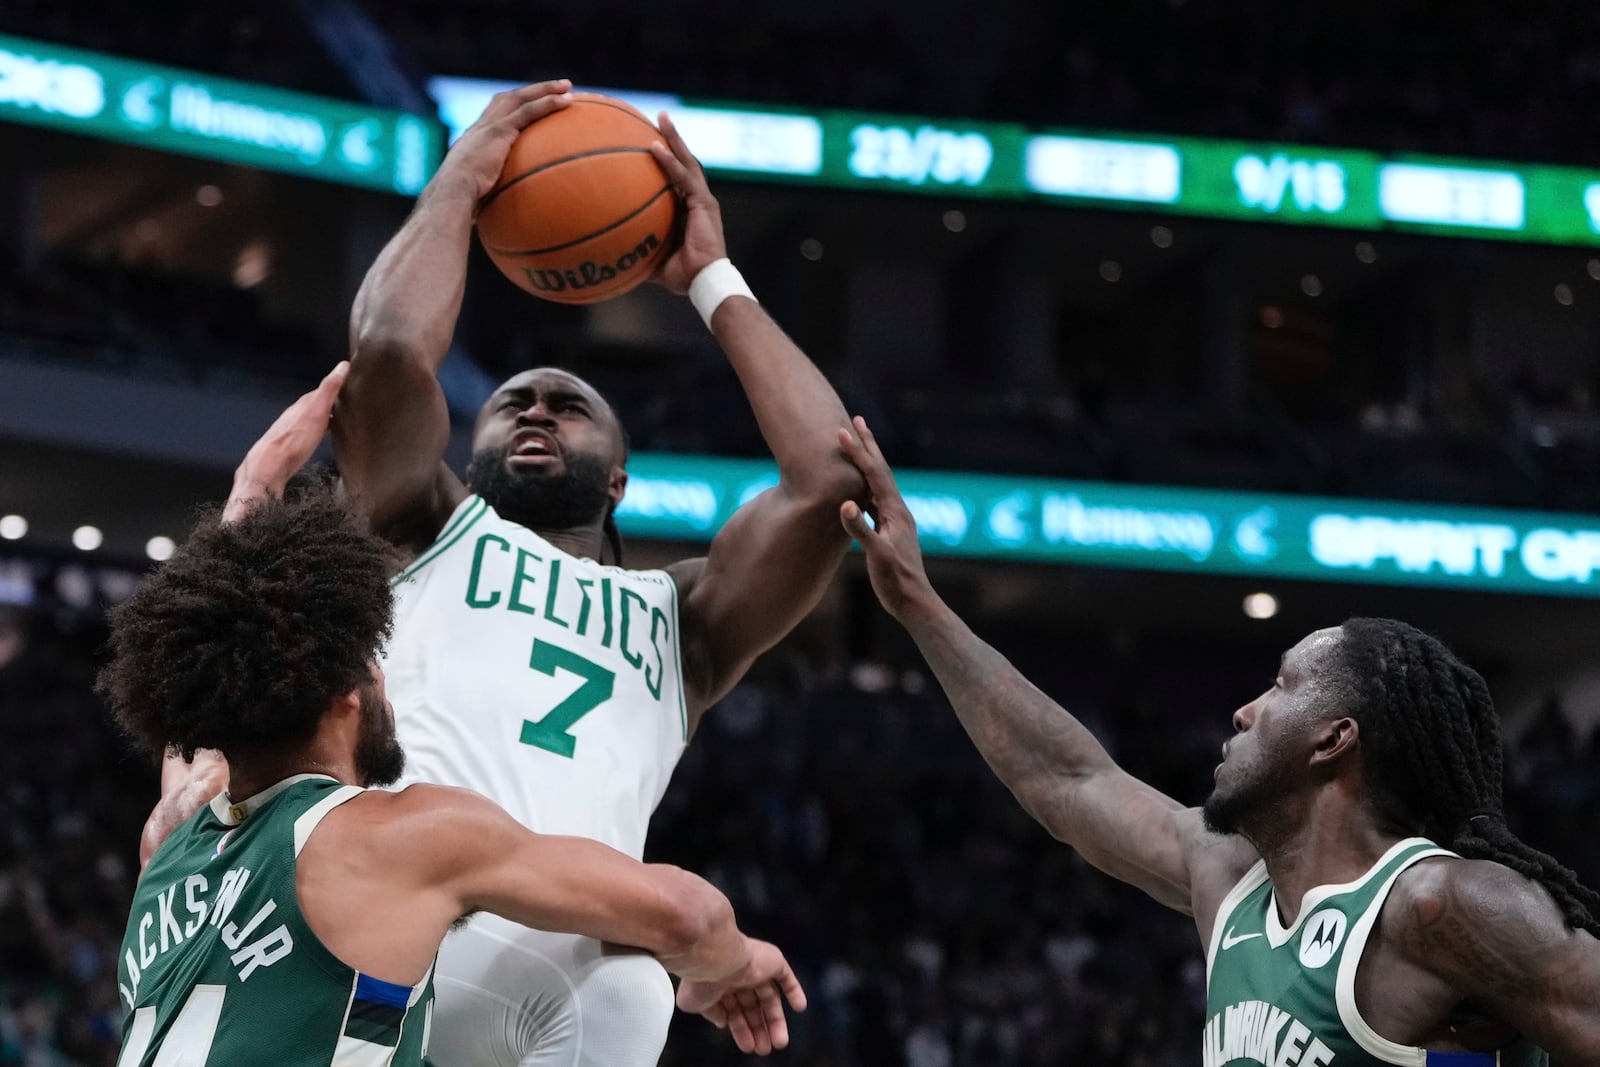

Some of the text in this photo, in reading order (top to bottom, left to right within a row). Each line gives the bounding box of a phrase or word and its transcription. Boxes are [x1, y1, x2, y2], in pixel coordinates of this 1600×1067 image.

[521, 233, 658, 291] Wilson
[465, 533, 668, 701] CELTICS
[519, 637, 616, 760] 7
[221, 898, 294, 983] JR
